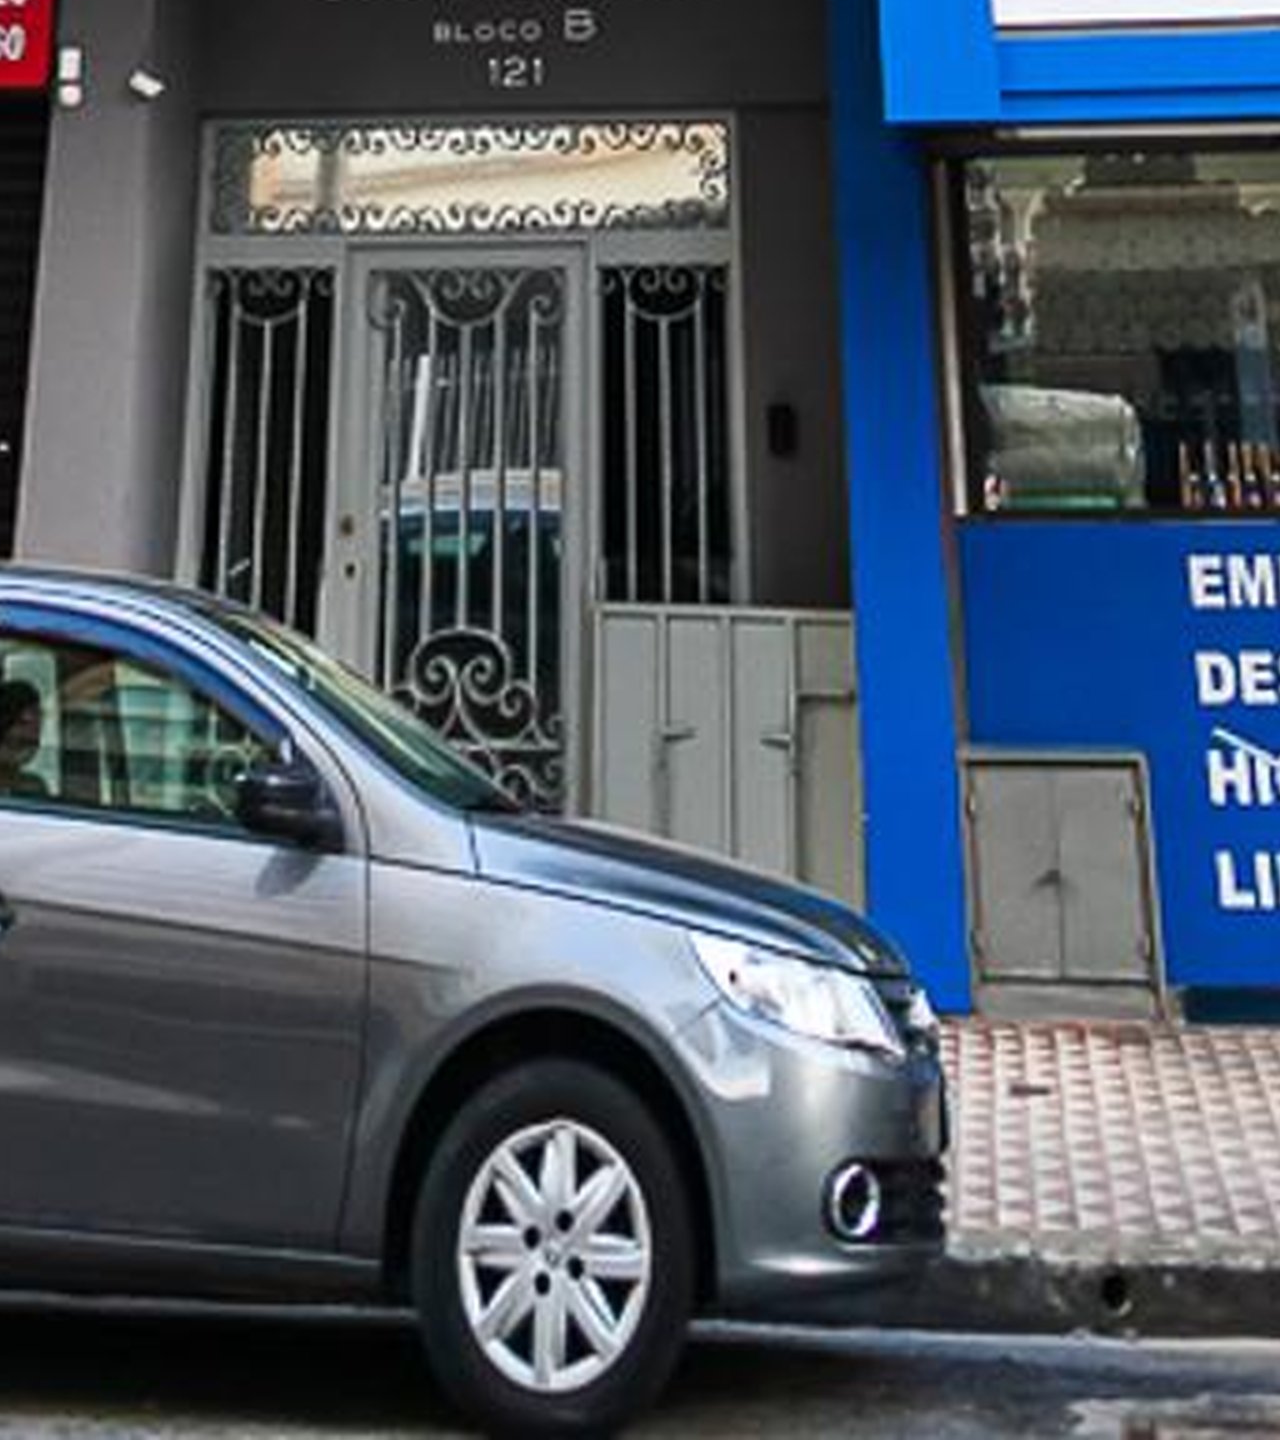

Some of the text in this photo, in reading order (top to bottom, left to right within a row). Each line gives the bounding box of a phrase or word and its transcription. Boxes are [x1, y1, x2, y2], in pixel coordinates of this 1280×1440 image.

[433, 8, 597, 43] BLOCO B
[488, 56, 544, 87] 121
